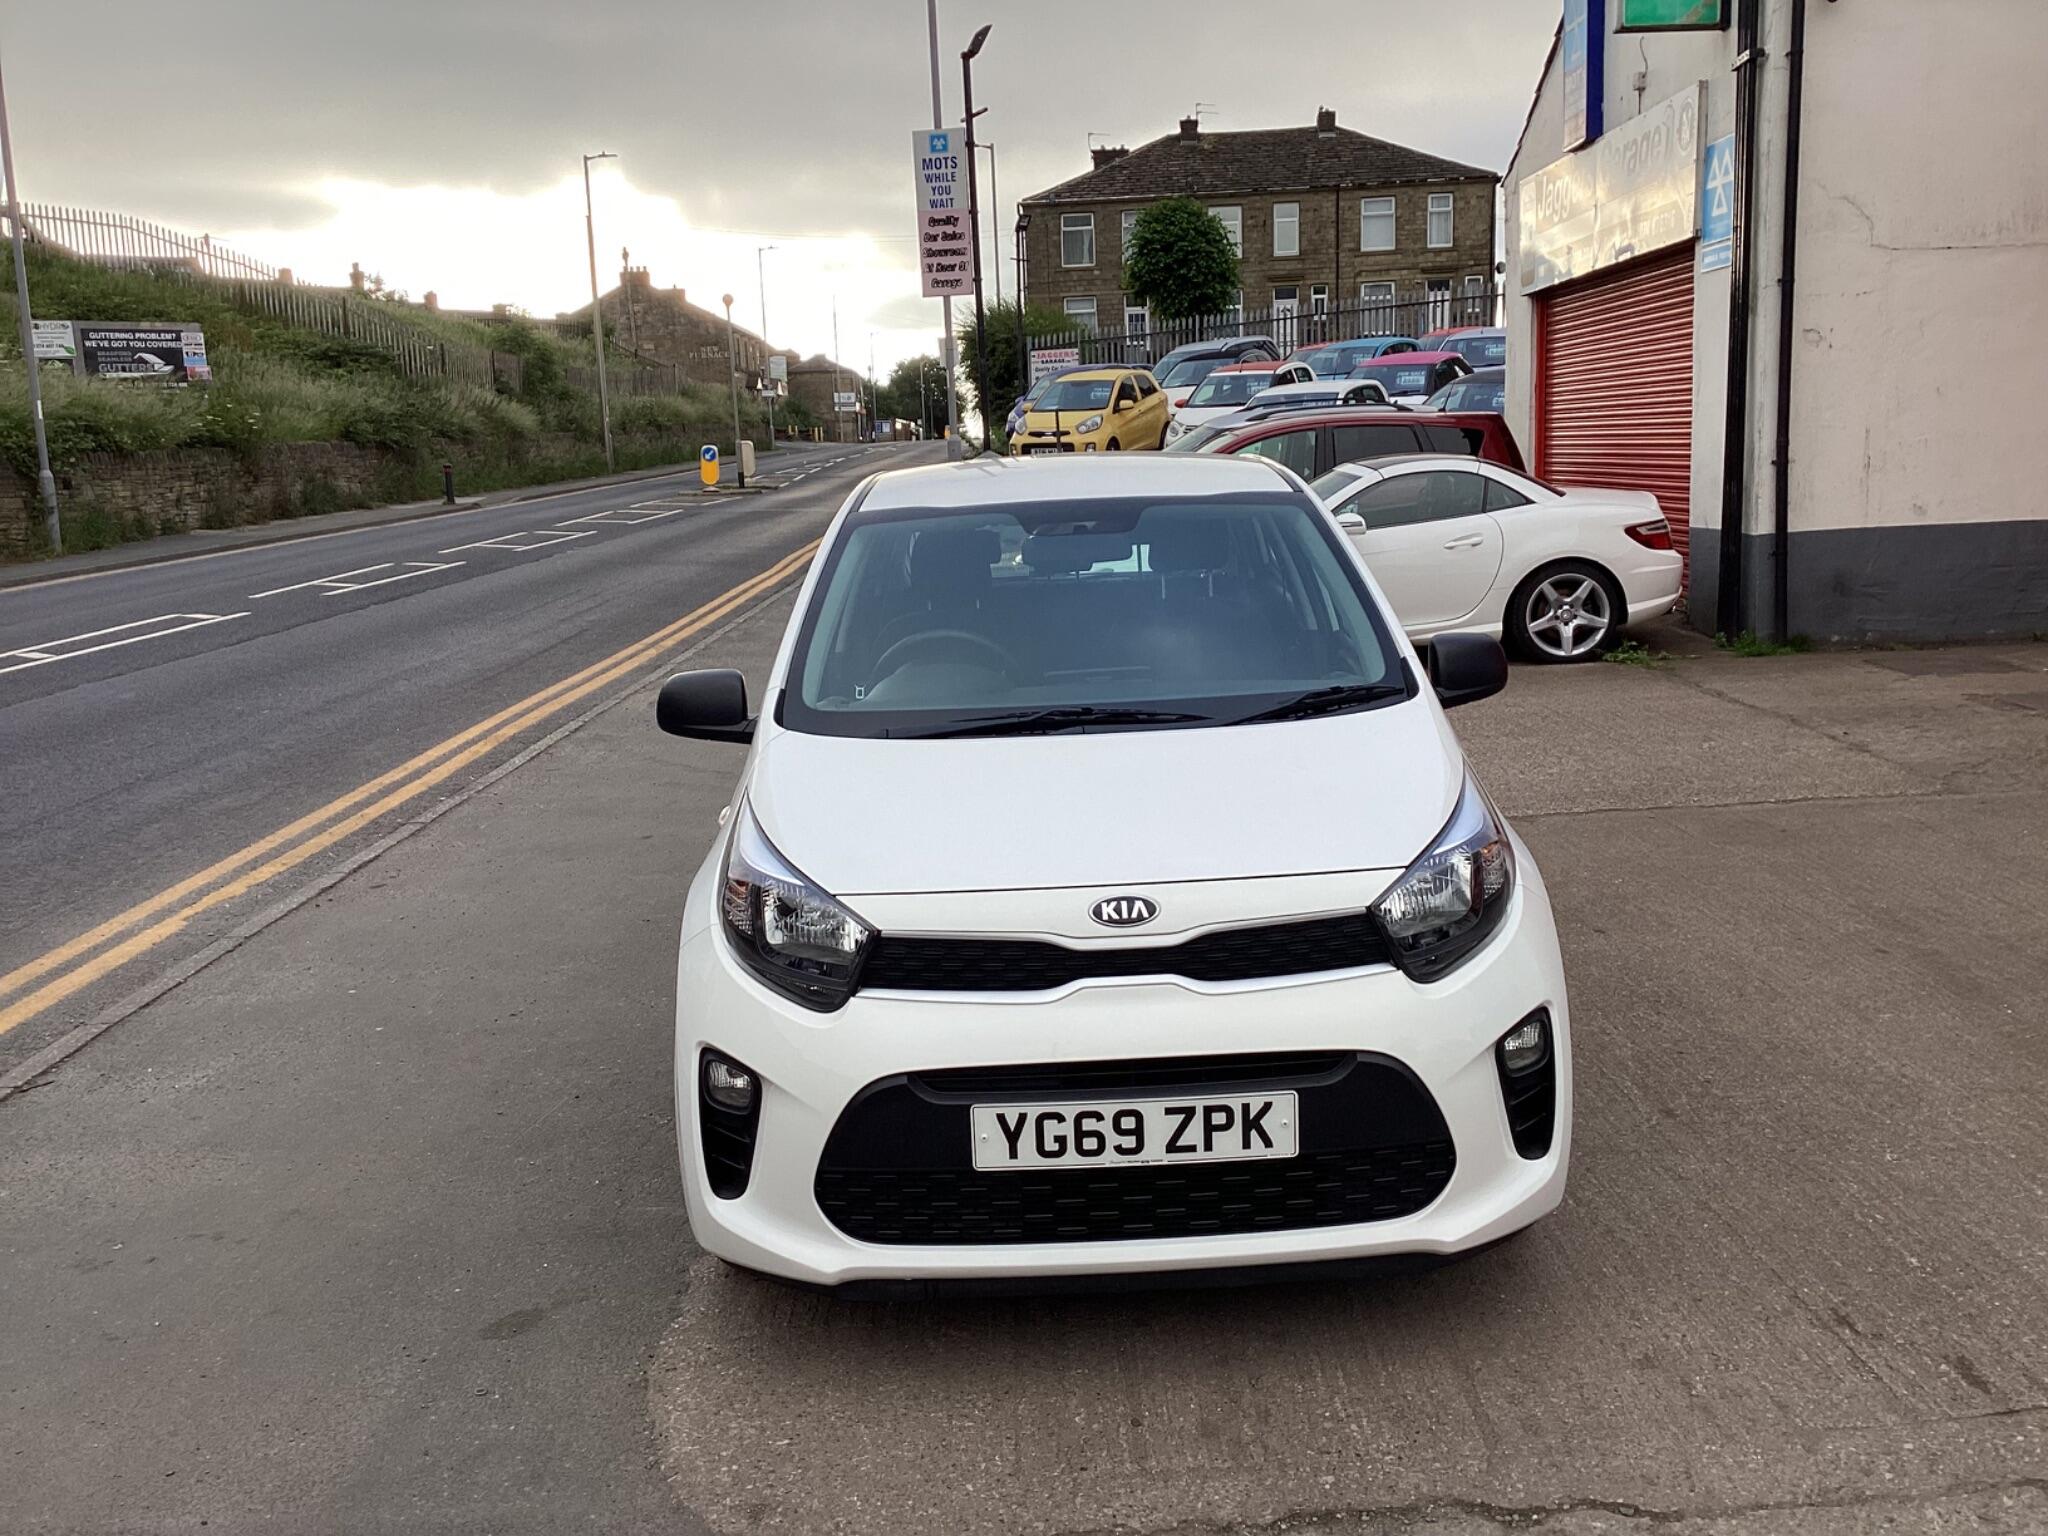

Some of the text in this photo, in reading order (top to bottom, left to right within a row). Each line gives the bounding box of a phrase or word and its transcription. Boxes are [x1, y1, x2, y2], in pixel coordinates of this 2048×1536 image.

[922, 156, 958, 170] MOTS
[925, 172, 956, 183] WHILE
[931, 185, 951, 196] YOU
[929, 198, 954, 208] WAIT
[135, 332, 176, 340] PROBLEM?
[1036, 351, 1074, 359] JAGGERS
[99, 363, 154, 372] GUTTERS
[1101, 900, 1149, 920] KIA
[996, 1101, 1274, 1160] YG69 ZPK
